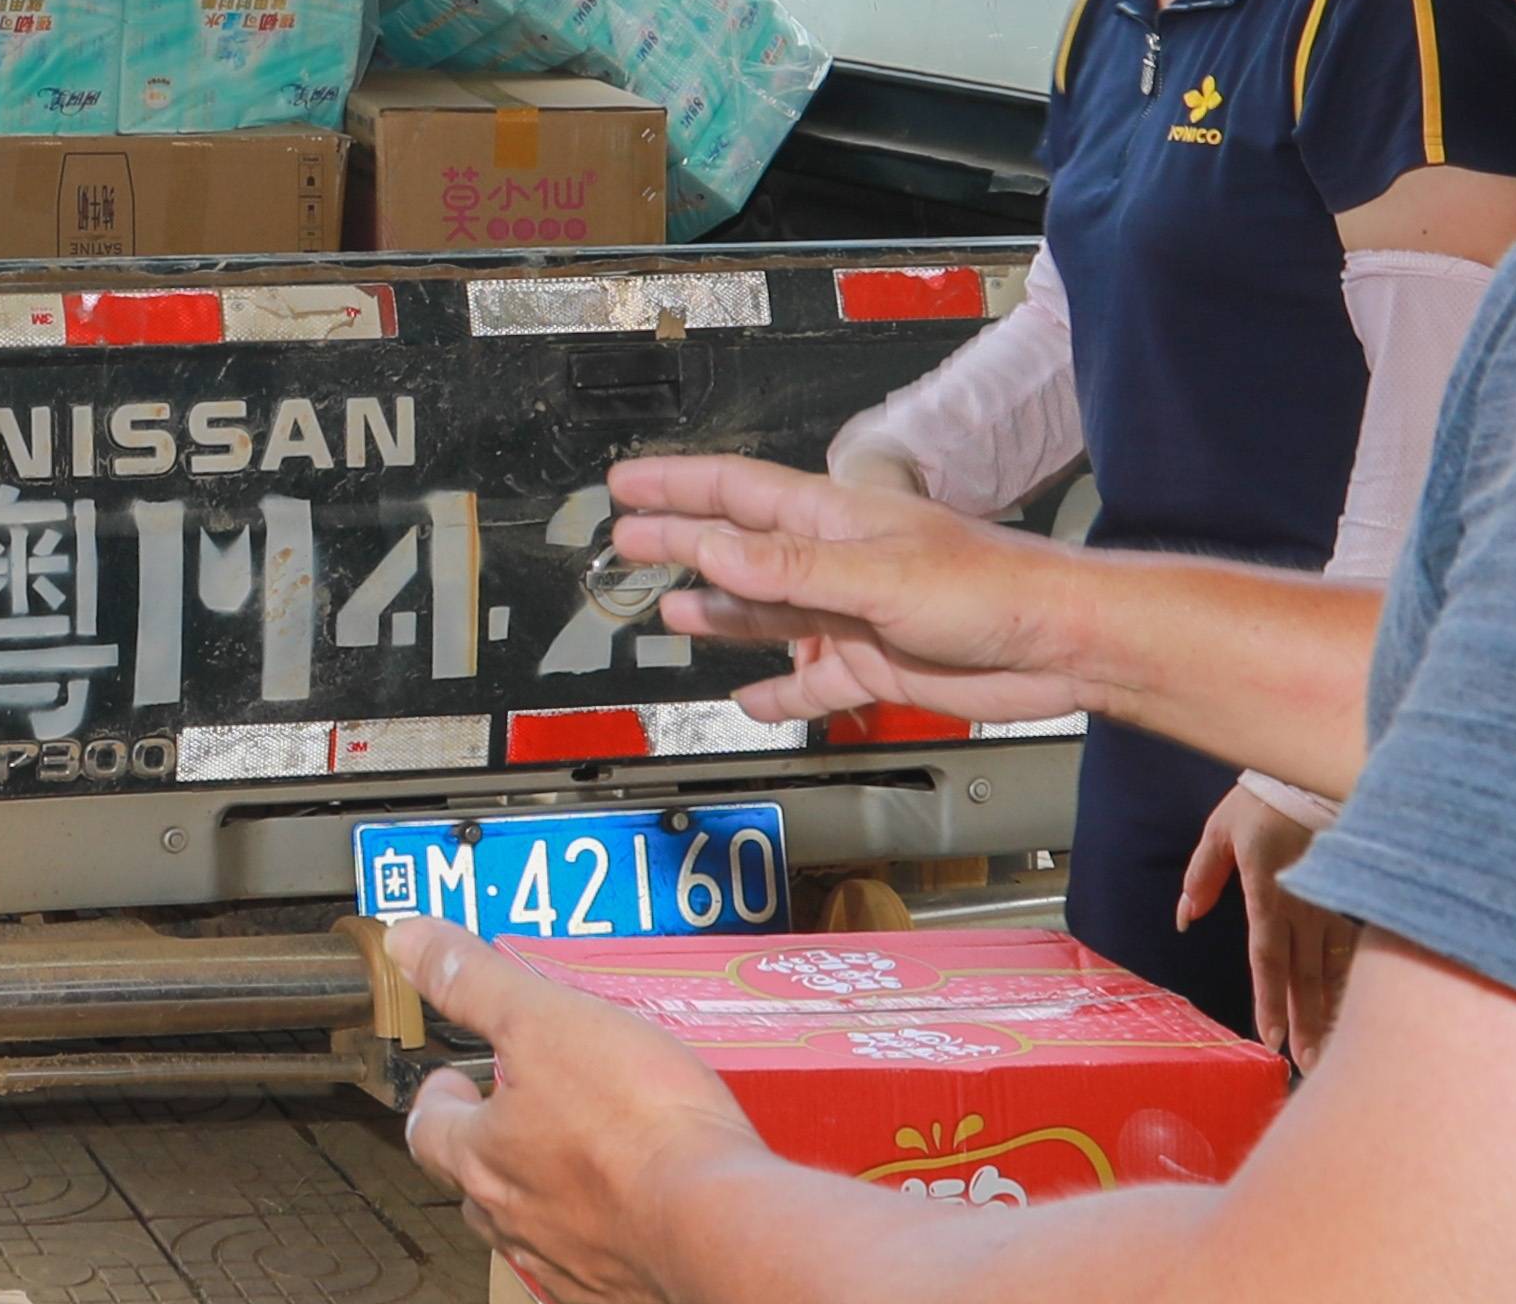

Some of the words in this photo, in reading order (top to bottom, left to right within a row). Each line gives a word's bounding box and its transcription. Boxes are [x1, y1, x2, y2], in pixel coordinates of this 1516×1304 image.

[441, 166, 585, 243] 莫小仙
[69, 241, 124, 255] SATINE
